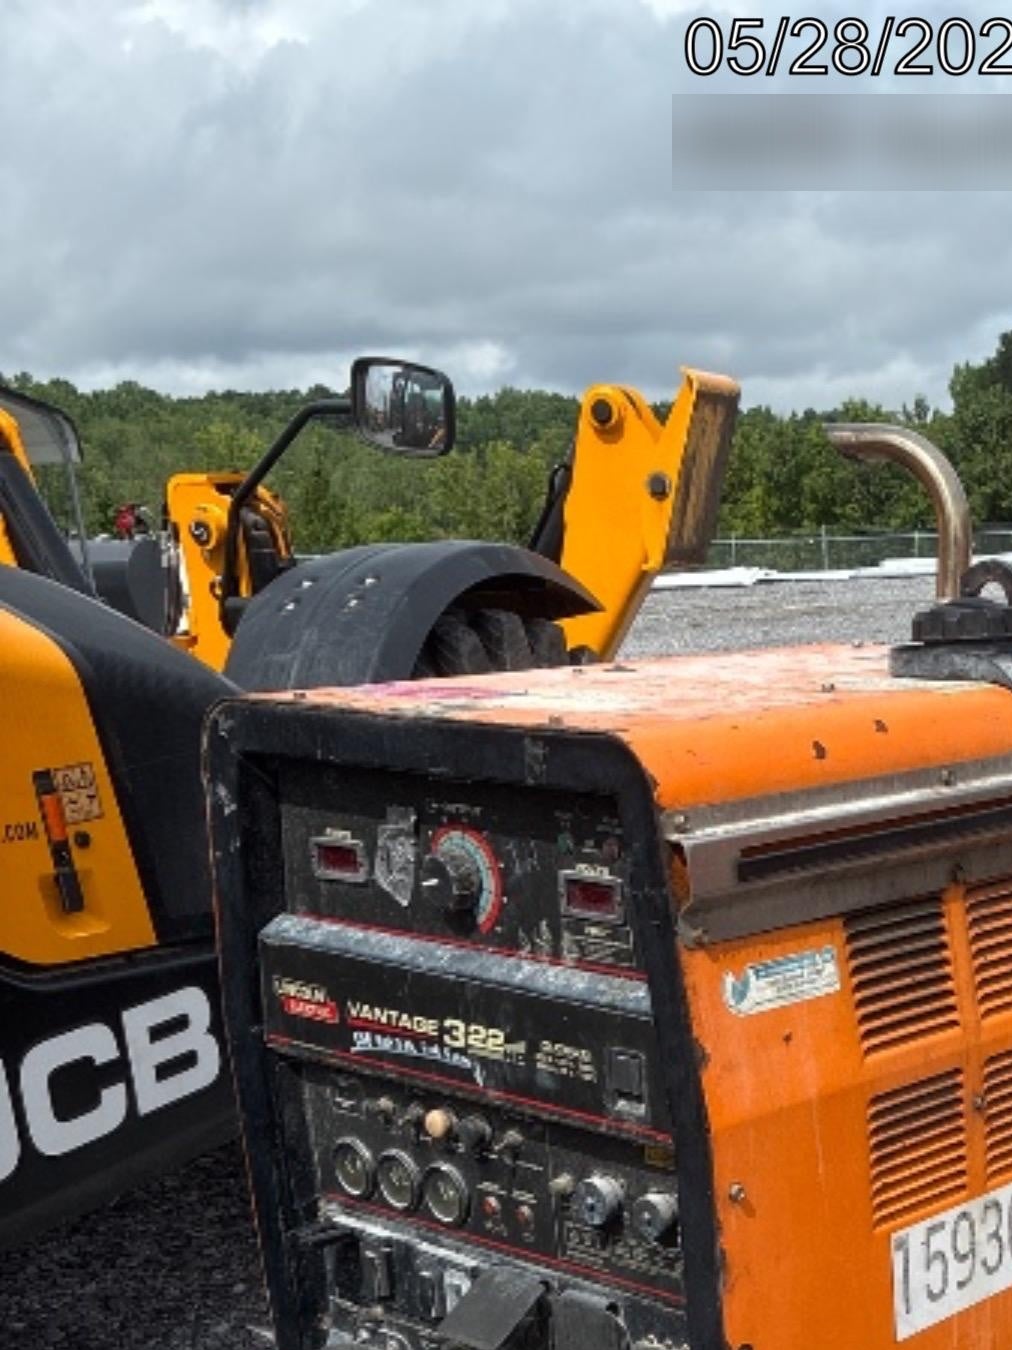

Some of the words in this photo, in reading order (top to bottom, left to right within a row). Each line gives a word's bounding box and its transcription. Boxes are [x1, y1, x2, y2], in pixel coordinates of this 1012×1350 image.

[0, 986, 220, 1180] CB
[347, 1000, 439, 1036] VANTAGE
[443, 1018, 505, 1051] 322
